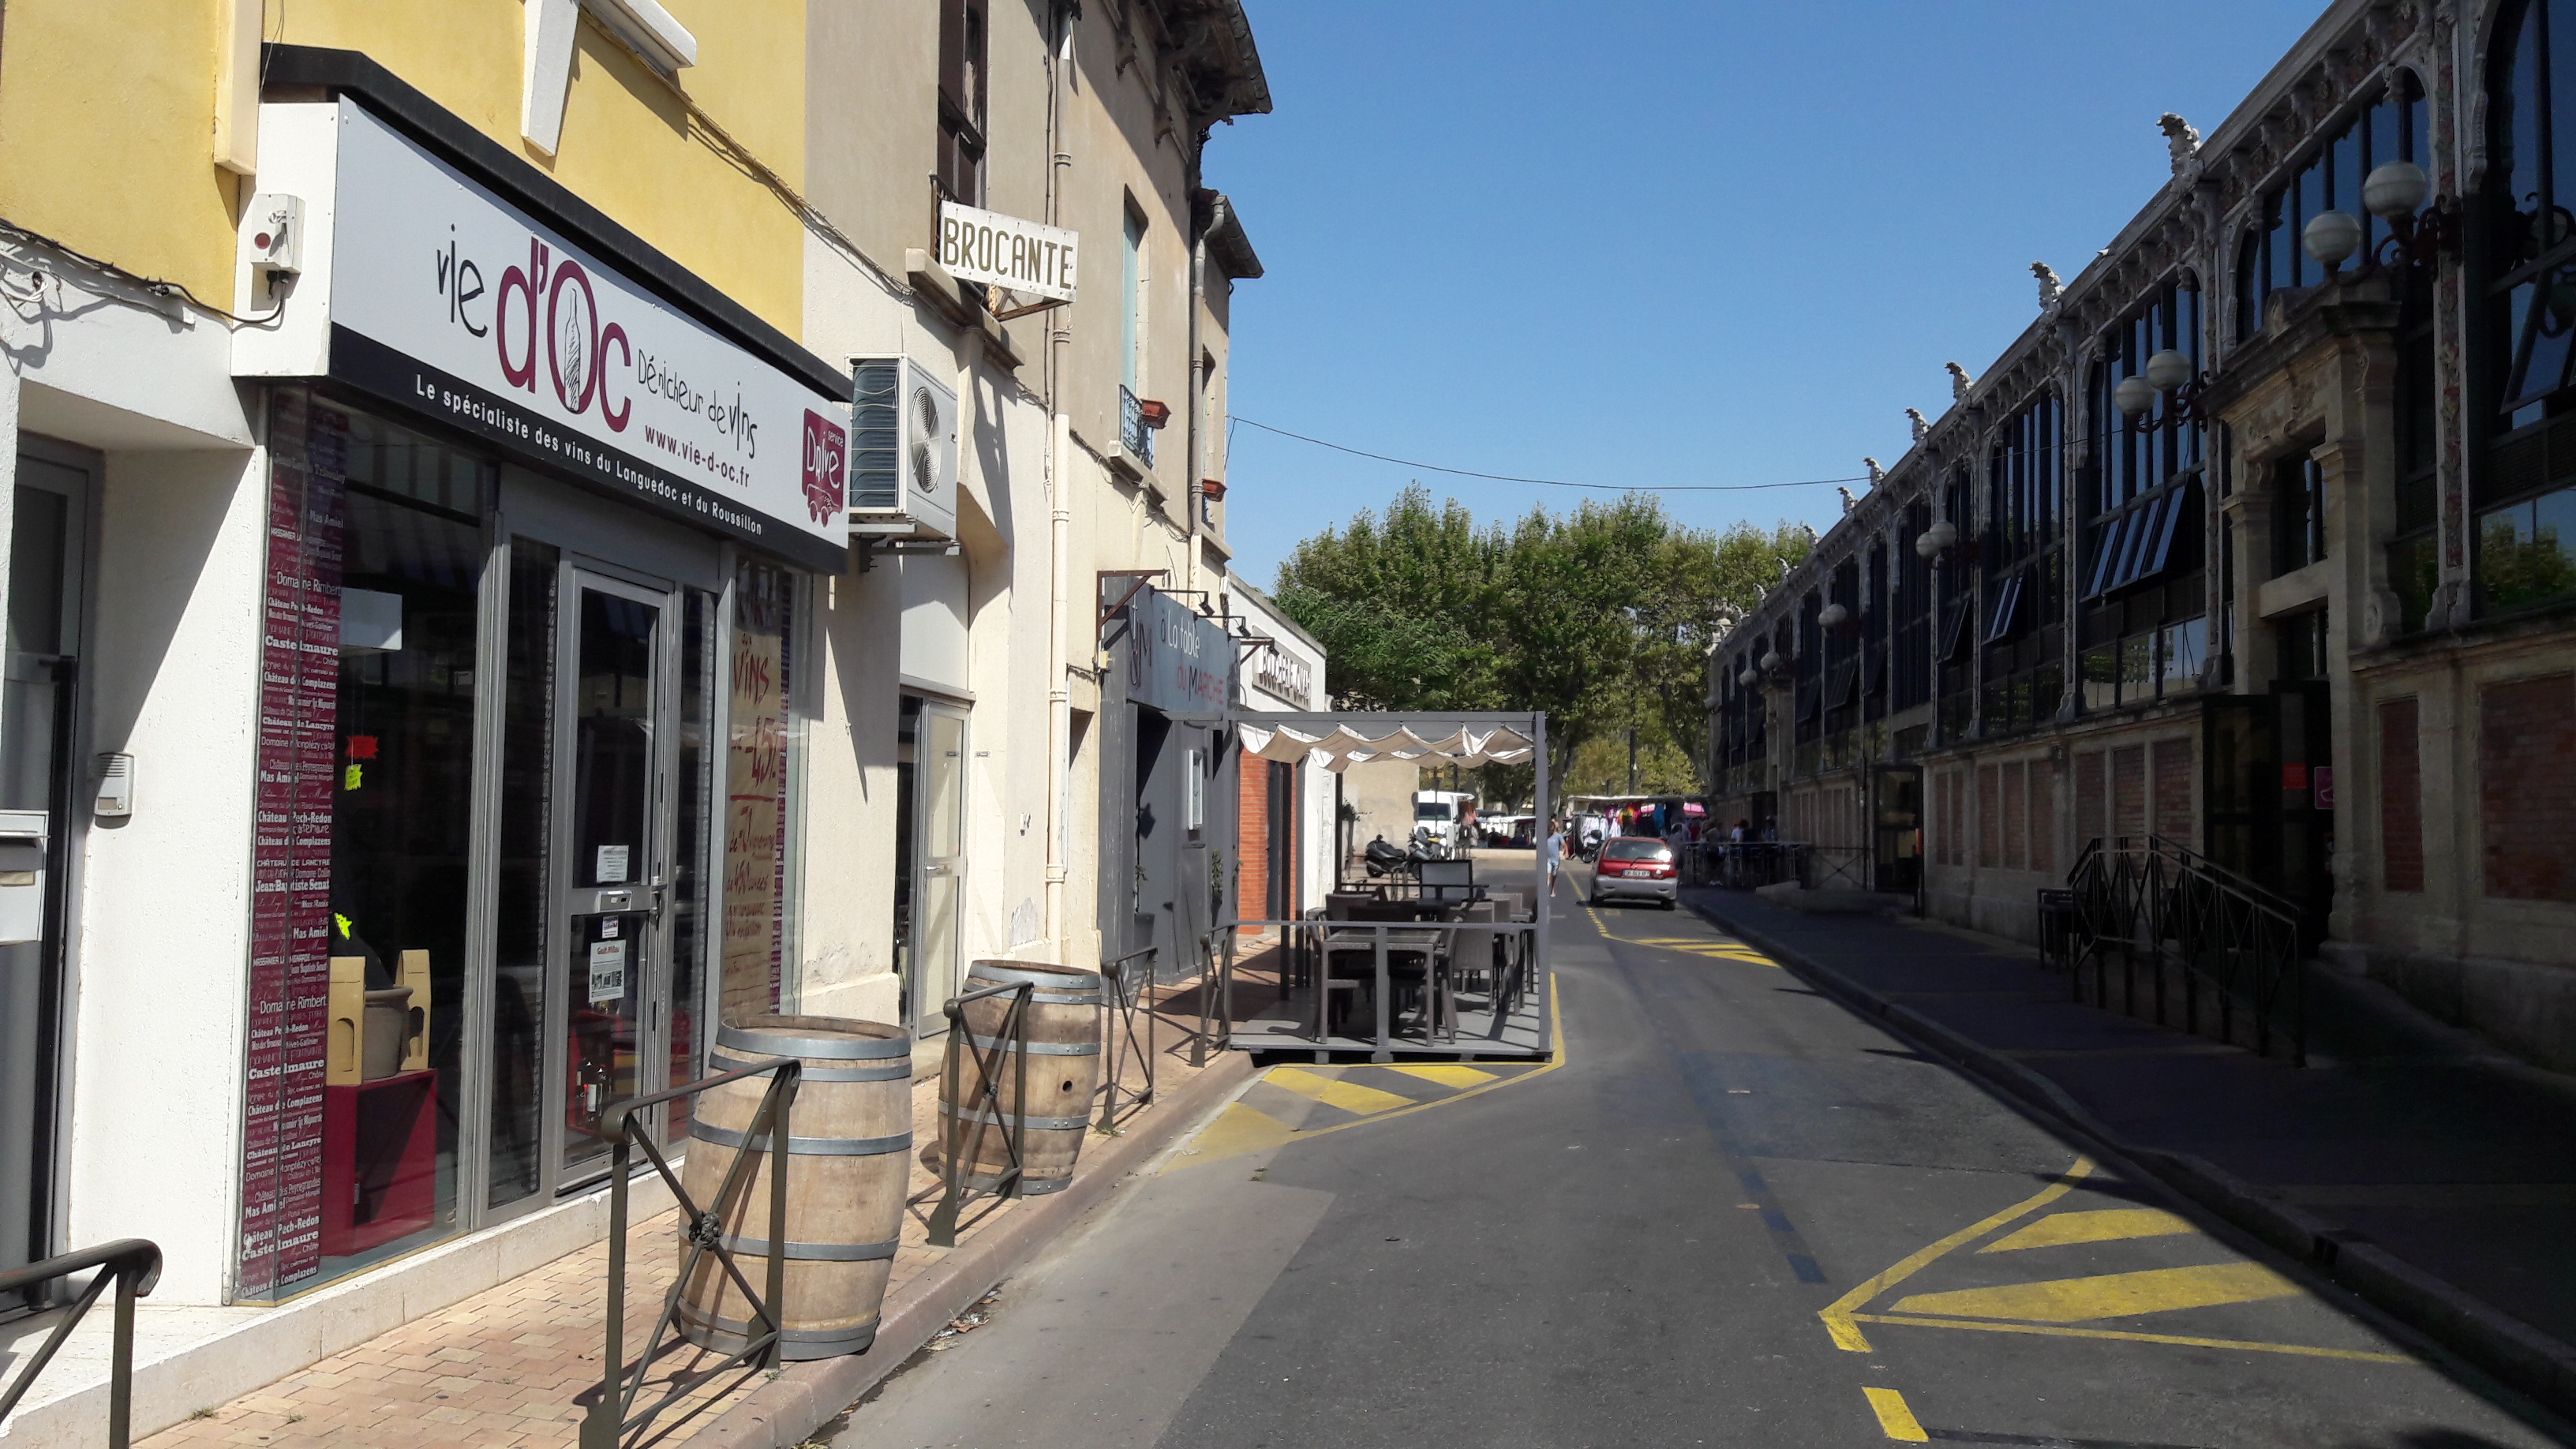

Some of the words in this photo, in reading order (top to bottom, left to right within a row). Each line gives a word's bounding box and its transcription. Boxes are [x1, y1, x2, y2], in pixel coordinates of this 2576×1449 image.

[943, 217, 1073, 290] BROCANTE
[436, 223, 488, 338] vie
[638, 349, 704, 416] Dénicheur
[708, 389, 726, 435] de
[728, 380, 758, 459] vins
[827, 429, 844, 447] service
[416, 374, 436, 399] Le
[444, 388, 530, 440] spécialiste
[535, 425, 559, 452] des
[564, 438, 592, 466] vins
[596, 450, 612, 474] du
[616, 459, 679, 503] Languedoc
[680, 488, 692, 507] et
[695, 492, 709, 515] du
[712, 499, 762, 536] Roussillon
[644, 423, 751, 489] www.vie-d-oc.fr
[1180, 616, 1200, 659] table
[260, 770, 275, 782] Mas
[257, 811, 287, 823] Château
[257, 835, 283, 846] Château
[293, 927, 307, 939] Mas
[309, 923, 329, 938] Amiel
[298, 994, 328, 1009] Rimbert
[248, 1058, 325, 1080] Castelmaure
[248, 1103, 274, 1117] Château
[286, 1094, 323, 1110] Complazens
[245, 1205, 260, 1219] Mas
[280, 1265, 317, 1284] Complazens
